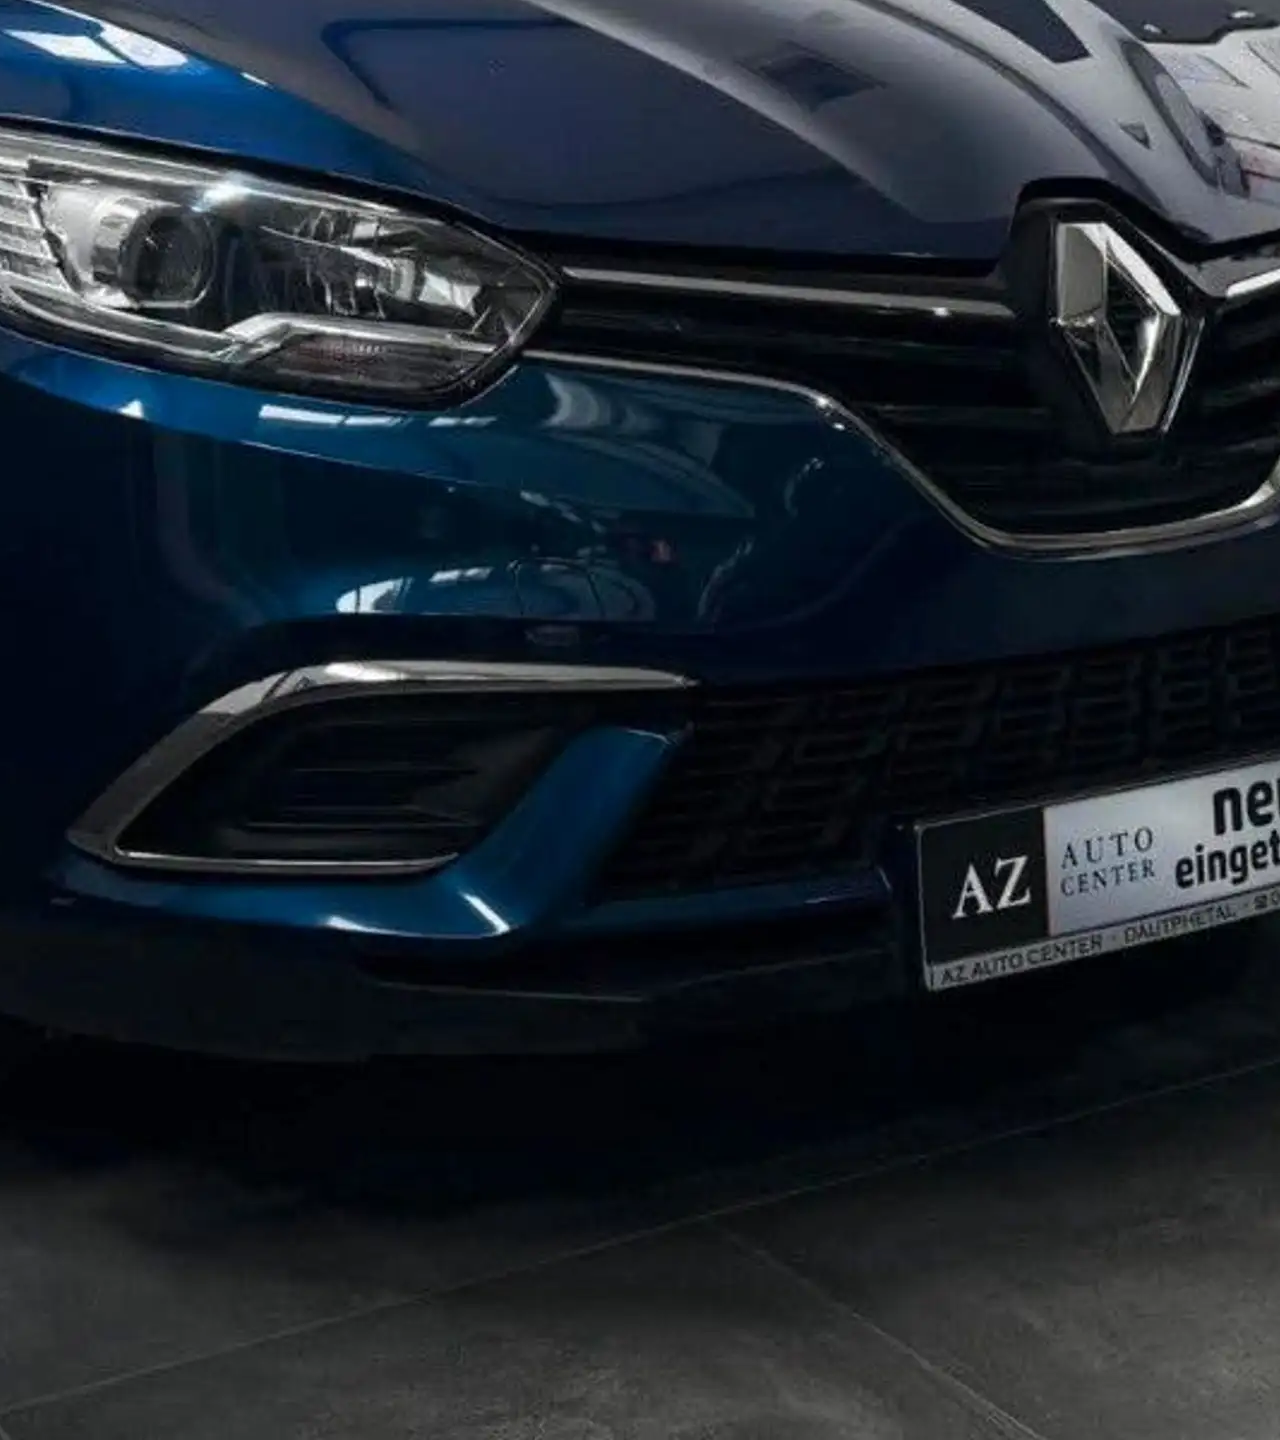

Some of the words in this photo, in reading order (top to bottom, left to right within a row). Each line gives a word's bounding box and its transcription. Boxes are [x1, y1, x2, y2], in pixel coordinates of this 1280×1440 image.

[1060, 826, 1154, 870] AUTO
[951, 854, 1032, 920] AZ
[1060, 858, 1156, 898] CENTER
[941, 965, 969, 986] AZ
[971, 953, 1022, 977] AUTO
[1025, 933, 1103, 965] CENTER
